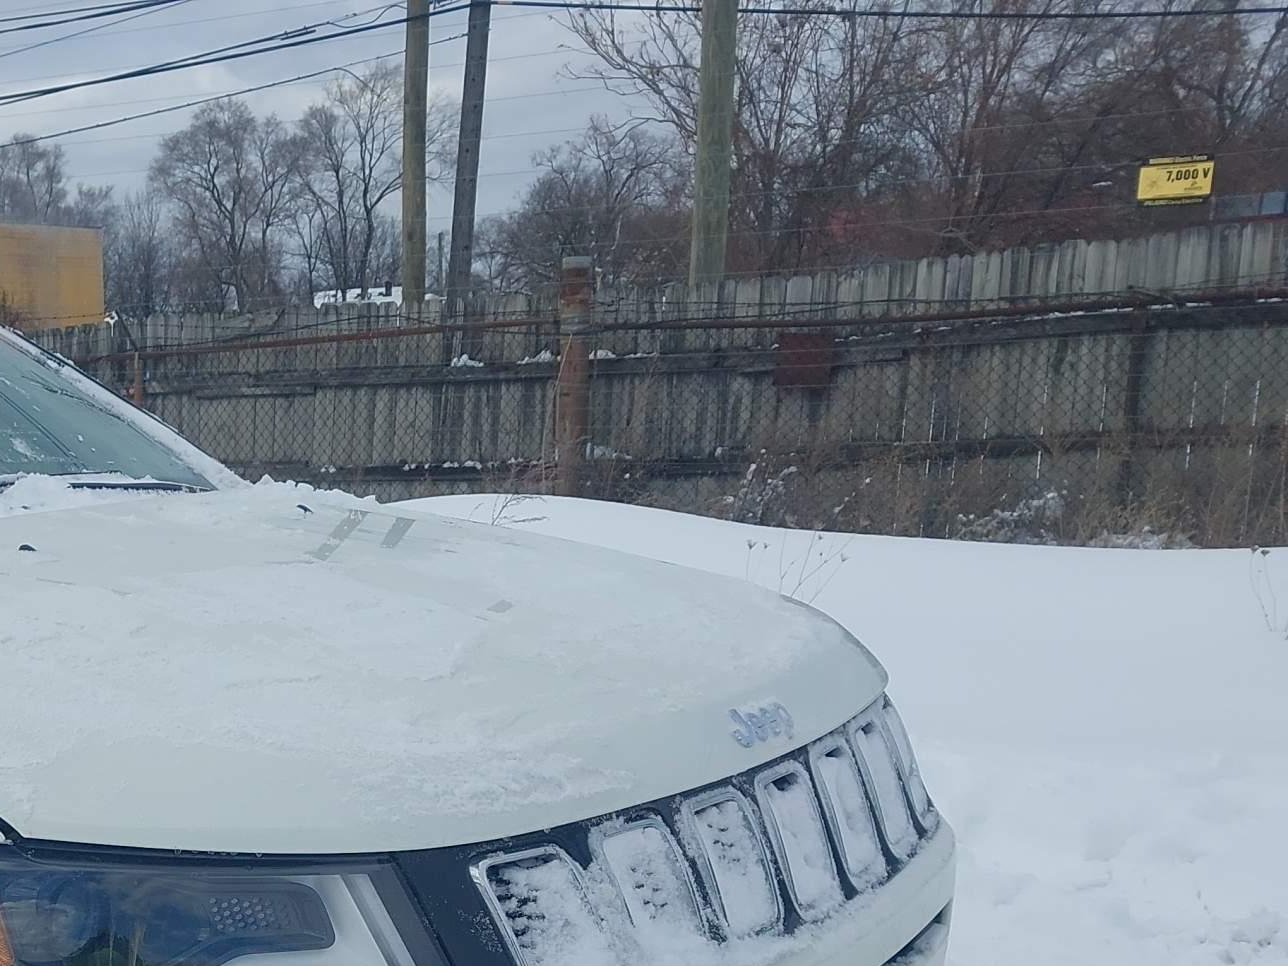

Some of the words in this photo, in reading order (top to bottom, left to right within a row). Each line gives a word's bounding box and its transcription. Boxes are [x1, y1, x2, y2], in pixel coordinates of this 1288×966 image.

[1165, 167, 1199, 183] 7,000
[1201, 166, 1211, 179] V
[728, 703, 793, 748] Jeep
